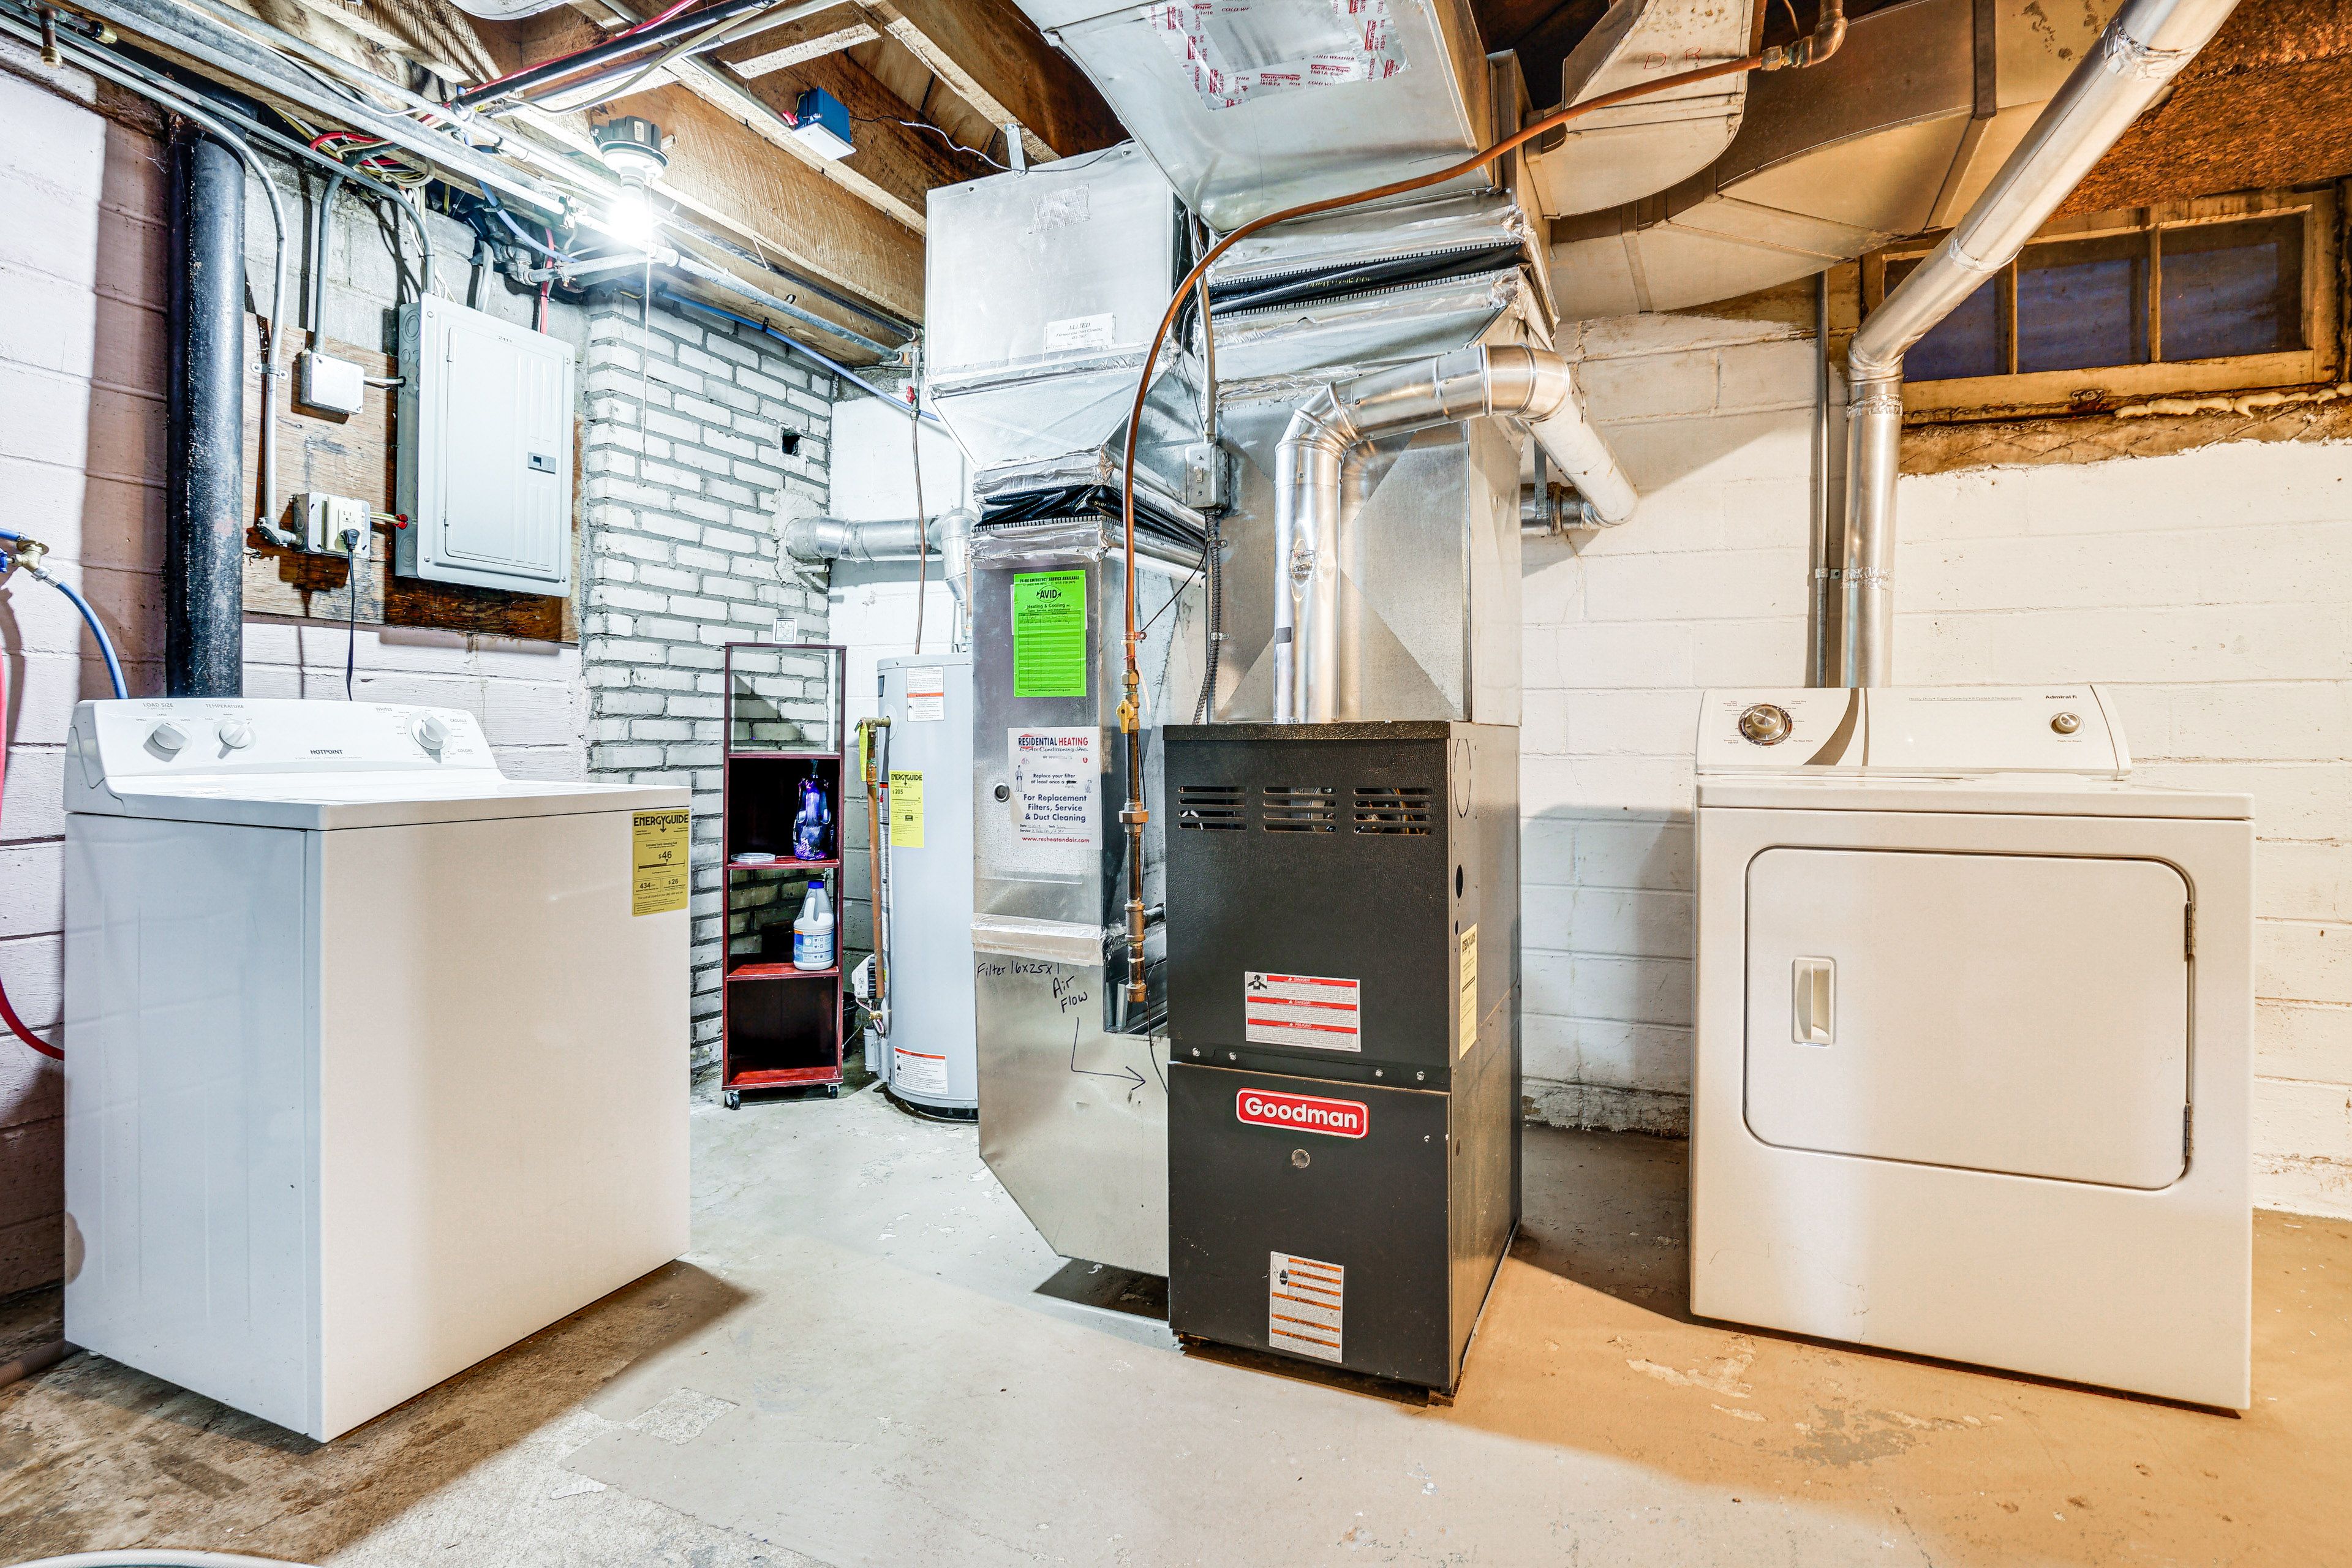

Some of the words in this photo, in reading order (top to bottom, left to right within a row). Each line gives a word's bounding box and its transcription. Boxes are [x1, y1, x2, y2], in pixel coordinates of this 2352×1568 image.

[1643, 52, 1667, 69] D
[1039, 589, 1057, 599] AVID
[1018, 737, 1057, 746] RESIDENTIAL
[1058, 737, 1088, 746] HEATING
[1038, 794, 1087, 802] Replacement
[633, 815, 689, 827] ENERGYGUIDE
[1052, 813, 1086, 823] Cleaning
[977, 962, 1006, 979] Filter
[1053, 976, 1075, 998] Air
[1061, 992, 1088, 1014] Flow
[1245, 1096, 1357, 1129] Goodman
